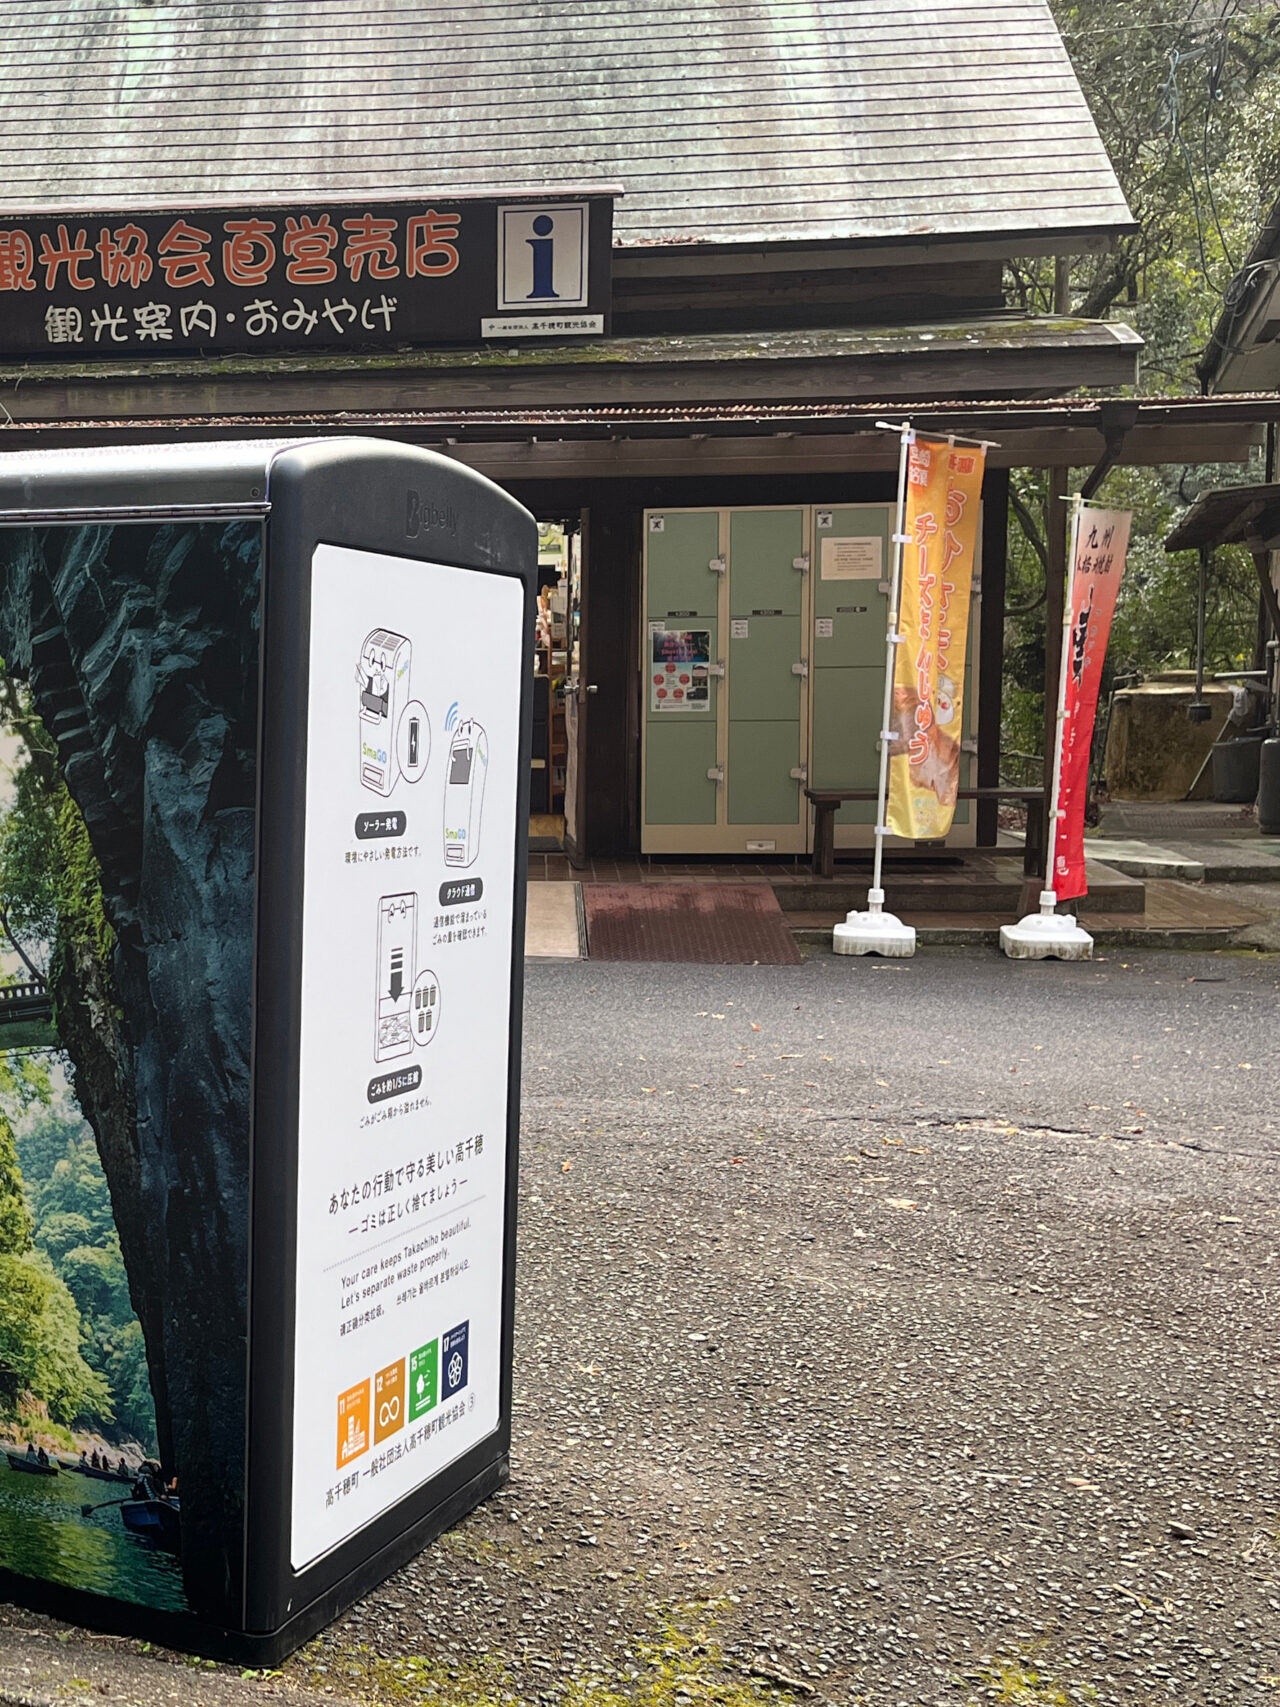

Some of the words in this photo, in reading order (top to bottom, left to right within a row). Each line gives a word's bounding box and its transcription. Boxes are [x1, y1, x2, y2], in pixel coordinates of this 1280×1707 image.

[44, 297, 399, 344] 観光案内・おみやげ
[1085, 524, 1115, 549] 九州
[363, 817, 398, 831] ソーラー発電
[328, 1134, 484, 1215] あなたの行動で守る美しい高千穂
[341, 1275, 359, 1289] Your
[361, 1264, 378, 1279] care
[380, 1253, 402, 1271] keeps
[404, 1233, 439, 1258] Takachiho
[441, 1217, 471, 1242] beautiful.
[341, 1290, 360, 1309] Let's
[362, 1275, 395, 1299] separate
[397, 1261, 418, 1280] waste
[420, 1248, 450, 1271] properly.
[325, 1471, 360, 1509] 高千穂町
